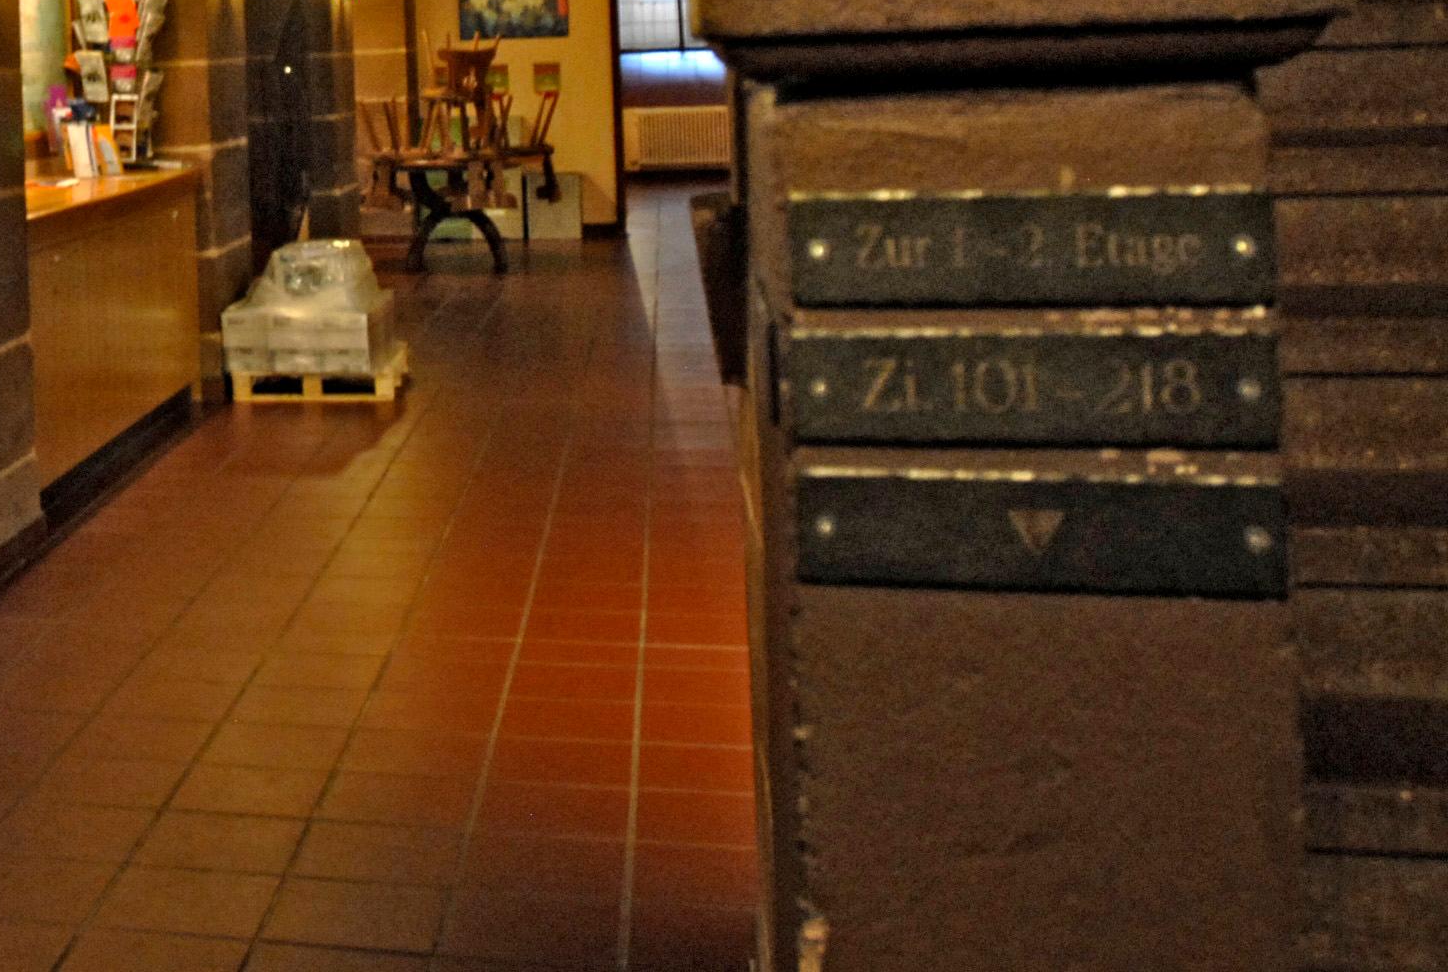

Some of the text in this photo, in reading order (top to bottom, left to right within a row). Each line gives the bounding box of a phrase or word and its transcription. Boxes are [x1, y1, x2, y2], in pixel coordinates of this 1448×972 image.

[855, 222, 932, 269] Zur
[1074, 221, 1204, 276] Etage
[951, 357, 1040, 413] 101
[1093, 357, 1204, 414] 218
